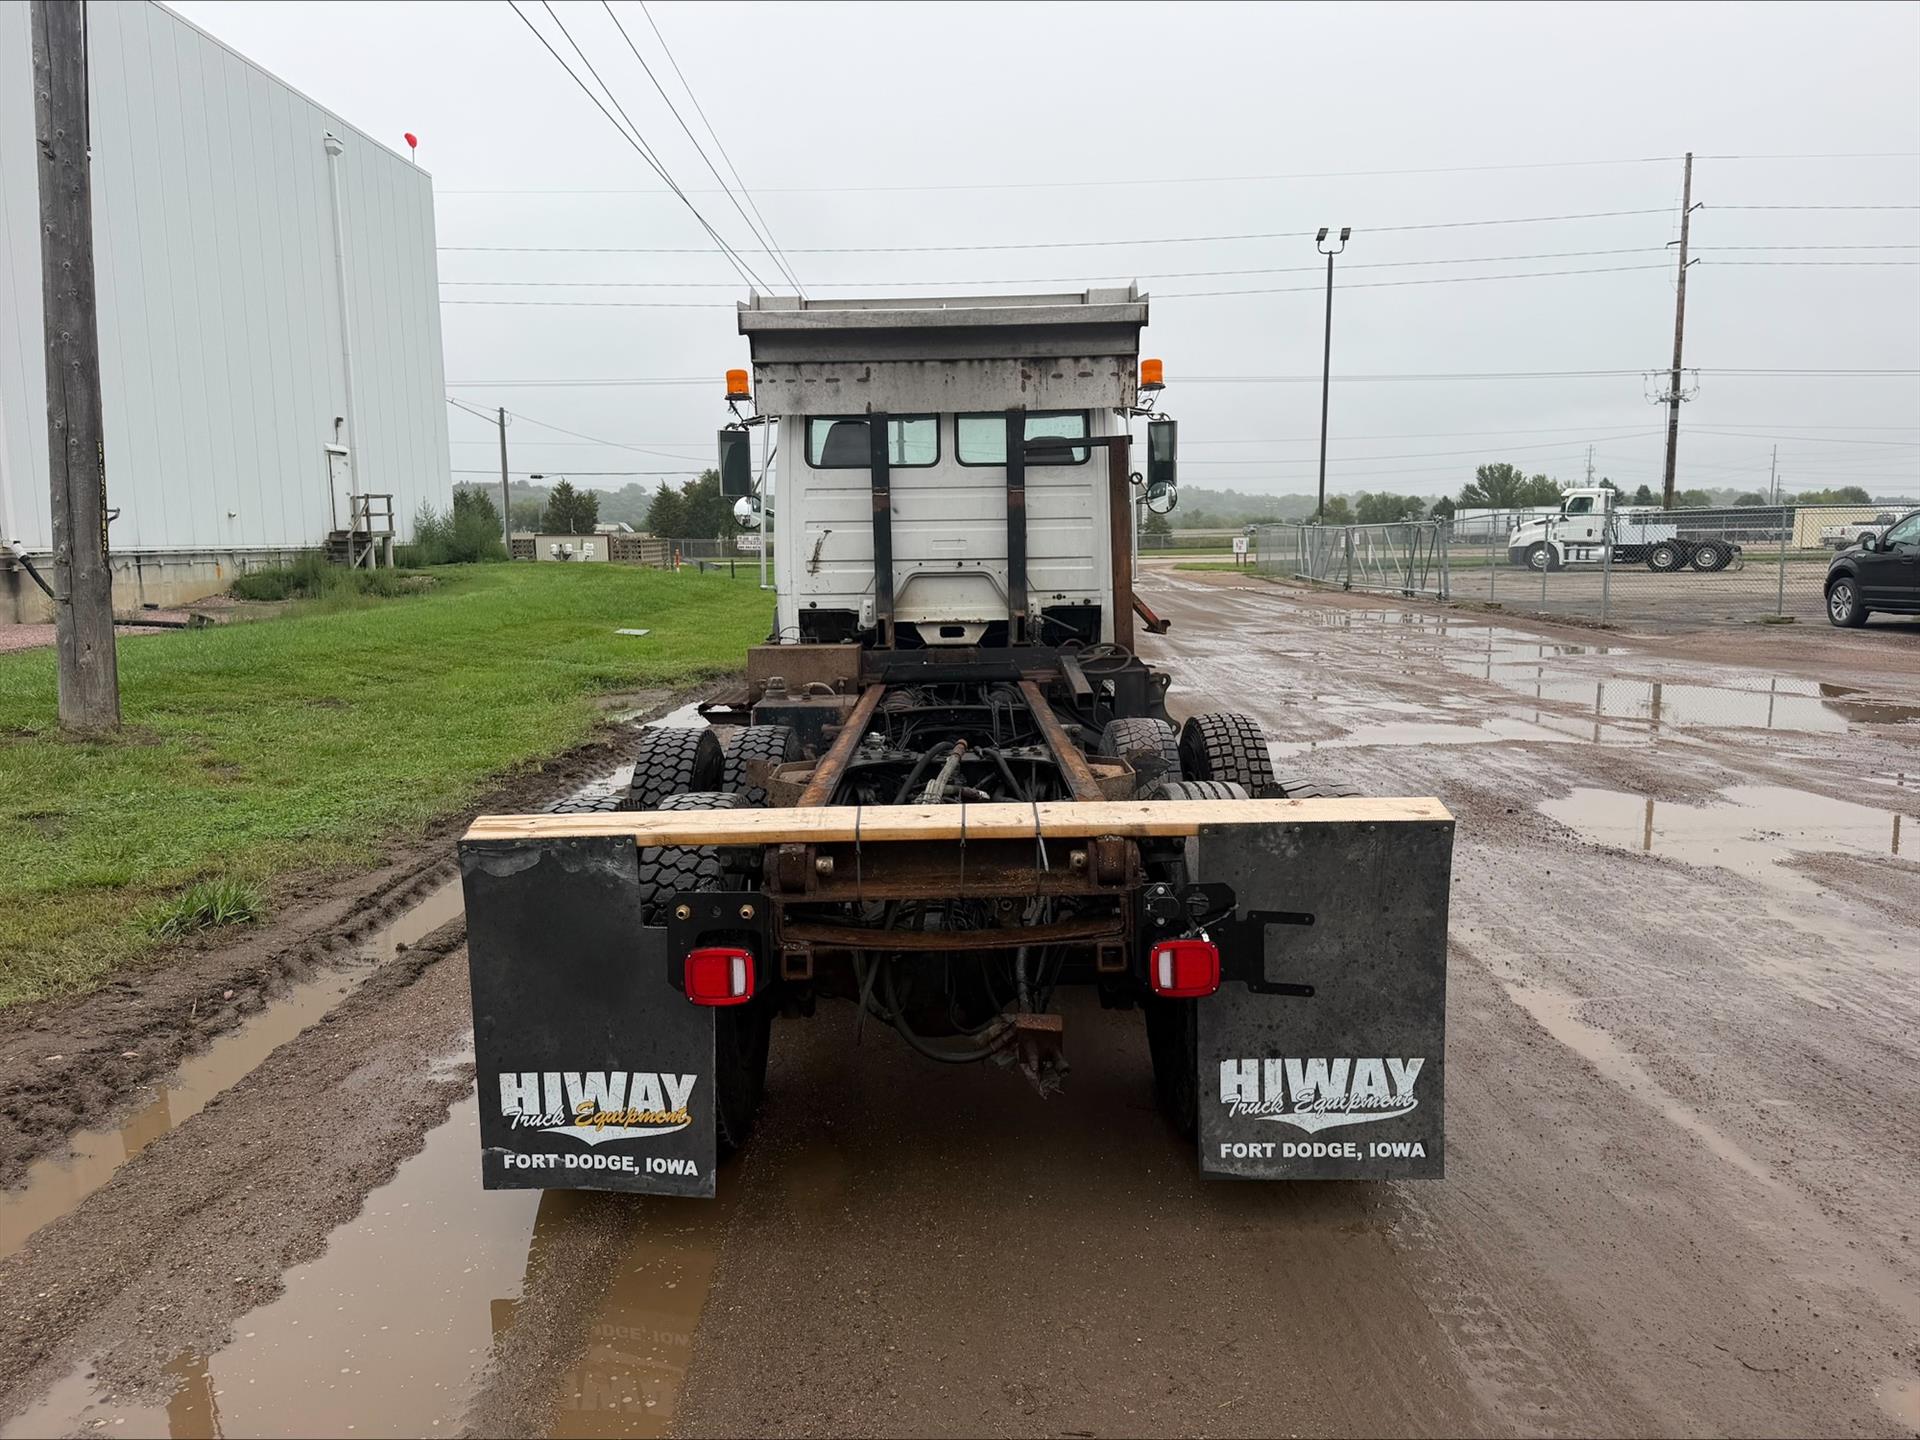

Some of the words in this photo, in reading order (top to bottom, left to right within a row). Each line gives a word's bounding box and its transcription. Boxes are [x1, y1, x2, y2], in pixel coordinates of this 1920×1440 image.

[499, 1071, 698, 1116] HIWAY
[1220, 1057, 1425, 1104] HIWAY
[502, 1104, 566, 1130] Truck
[574, 1099, 692, 1132] Equipment
[1221, 1092, 1284, 1119] Truck
[1293, 1087, 1419, 1120] Equipment
[503, 1153, 558, 1169] FORT
[564, 1153, 640, 1175] DODGE,
[646, 1157, 699, 1177] IOWA
[1220, 1142, 1276, 1159] FORT
[1283, 1142, 1363, 1161] DODGE,
[1369, 1142, 1426, 1158] IOWA
